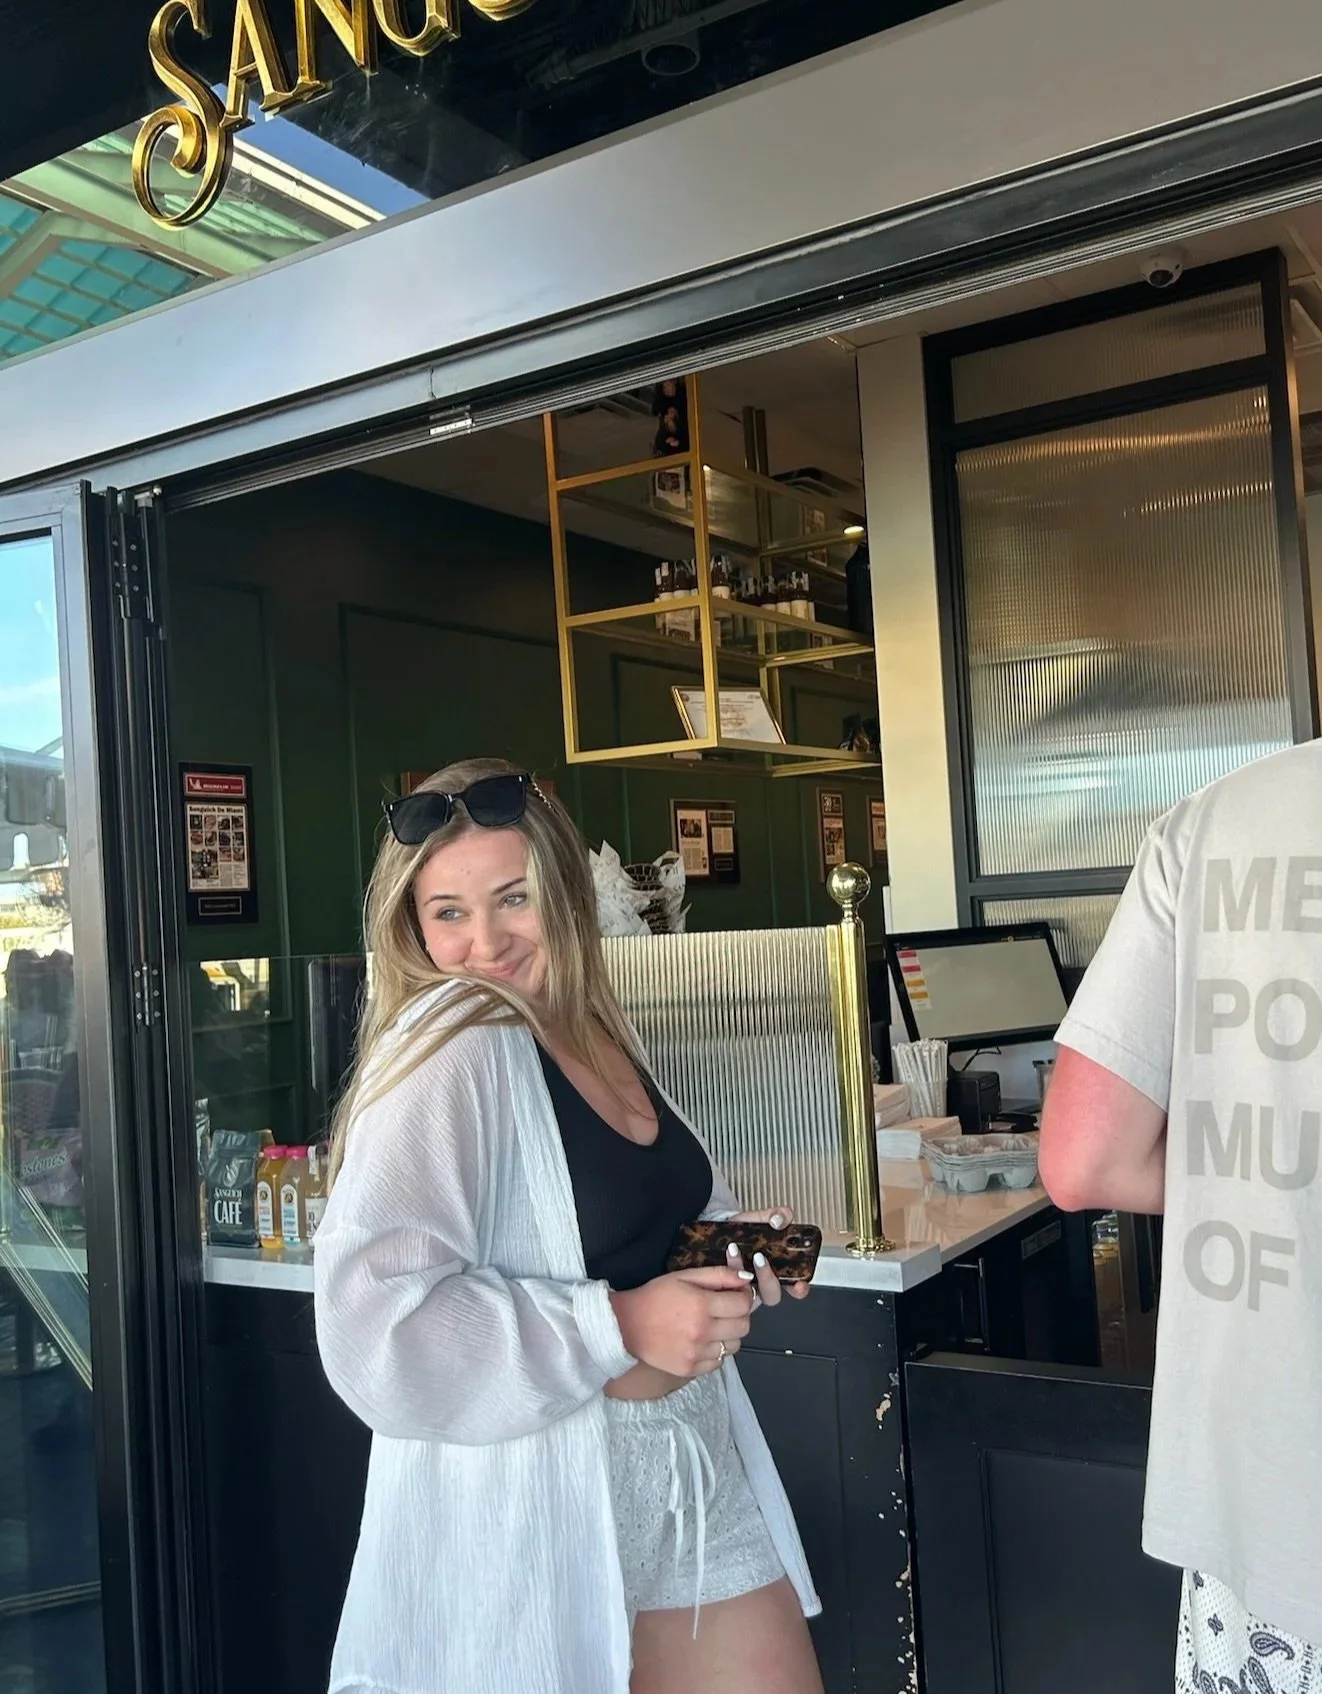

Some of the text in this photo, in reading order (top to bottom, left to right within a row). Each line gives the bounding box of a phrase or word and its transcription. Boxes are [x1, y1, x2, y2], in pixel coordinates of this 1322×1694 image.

[1203, 856, 1322, 934] ME
[1194, 978, 1322, 1062] PO
[1186, 1100, 1321, 1191] MU
[213, 1199, 243, 1225] CAFÉ
[1183, 1219, 1296, 1312] OF
